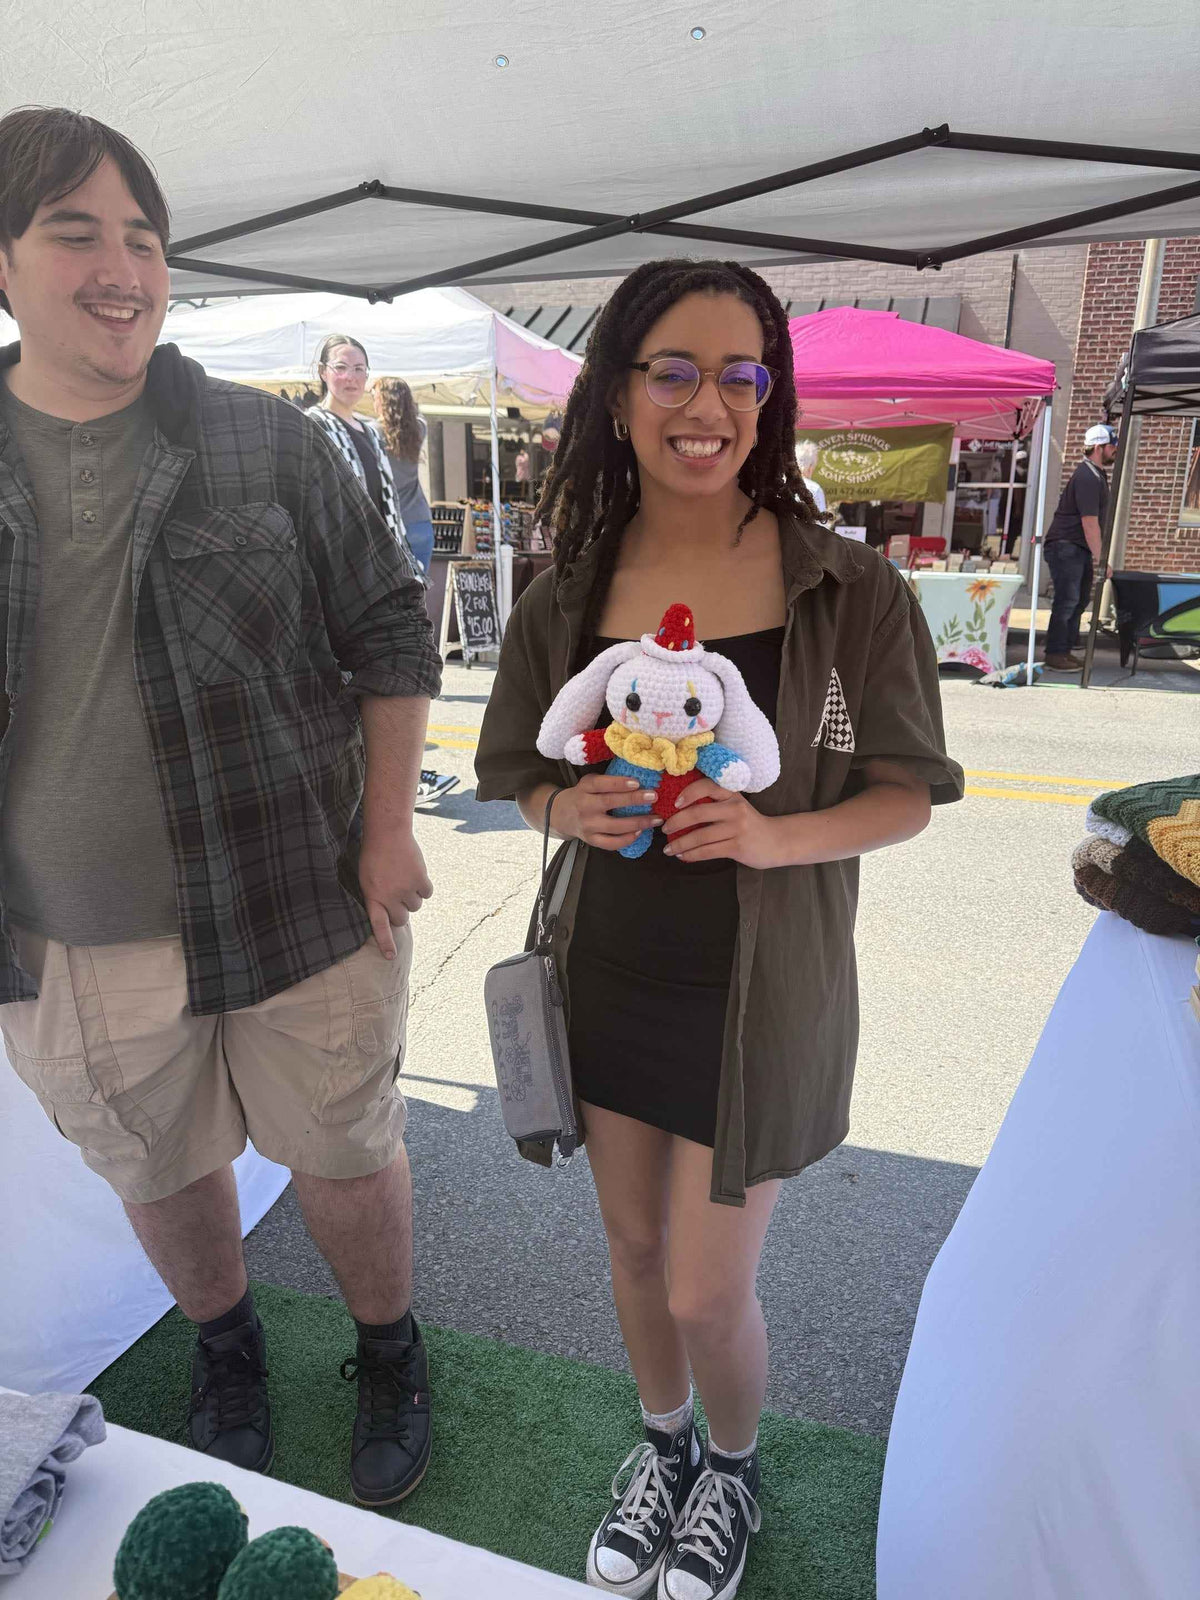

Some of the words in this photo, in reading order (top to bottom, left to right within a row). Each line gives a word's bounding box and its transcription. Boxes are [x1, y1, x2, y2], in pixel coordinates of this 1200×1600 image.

[847, 433, 891, 451] SPRINGS
[818, 468, 845, 482] SOAP
[846, 467, 886, 484] SHOPPE
[464, 593, 473, 612] 2
[473, 595, 490, 611] FOR
